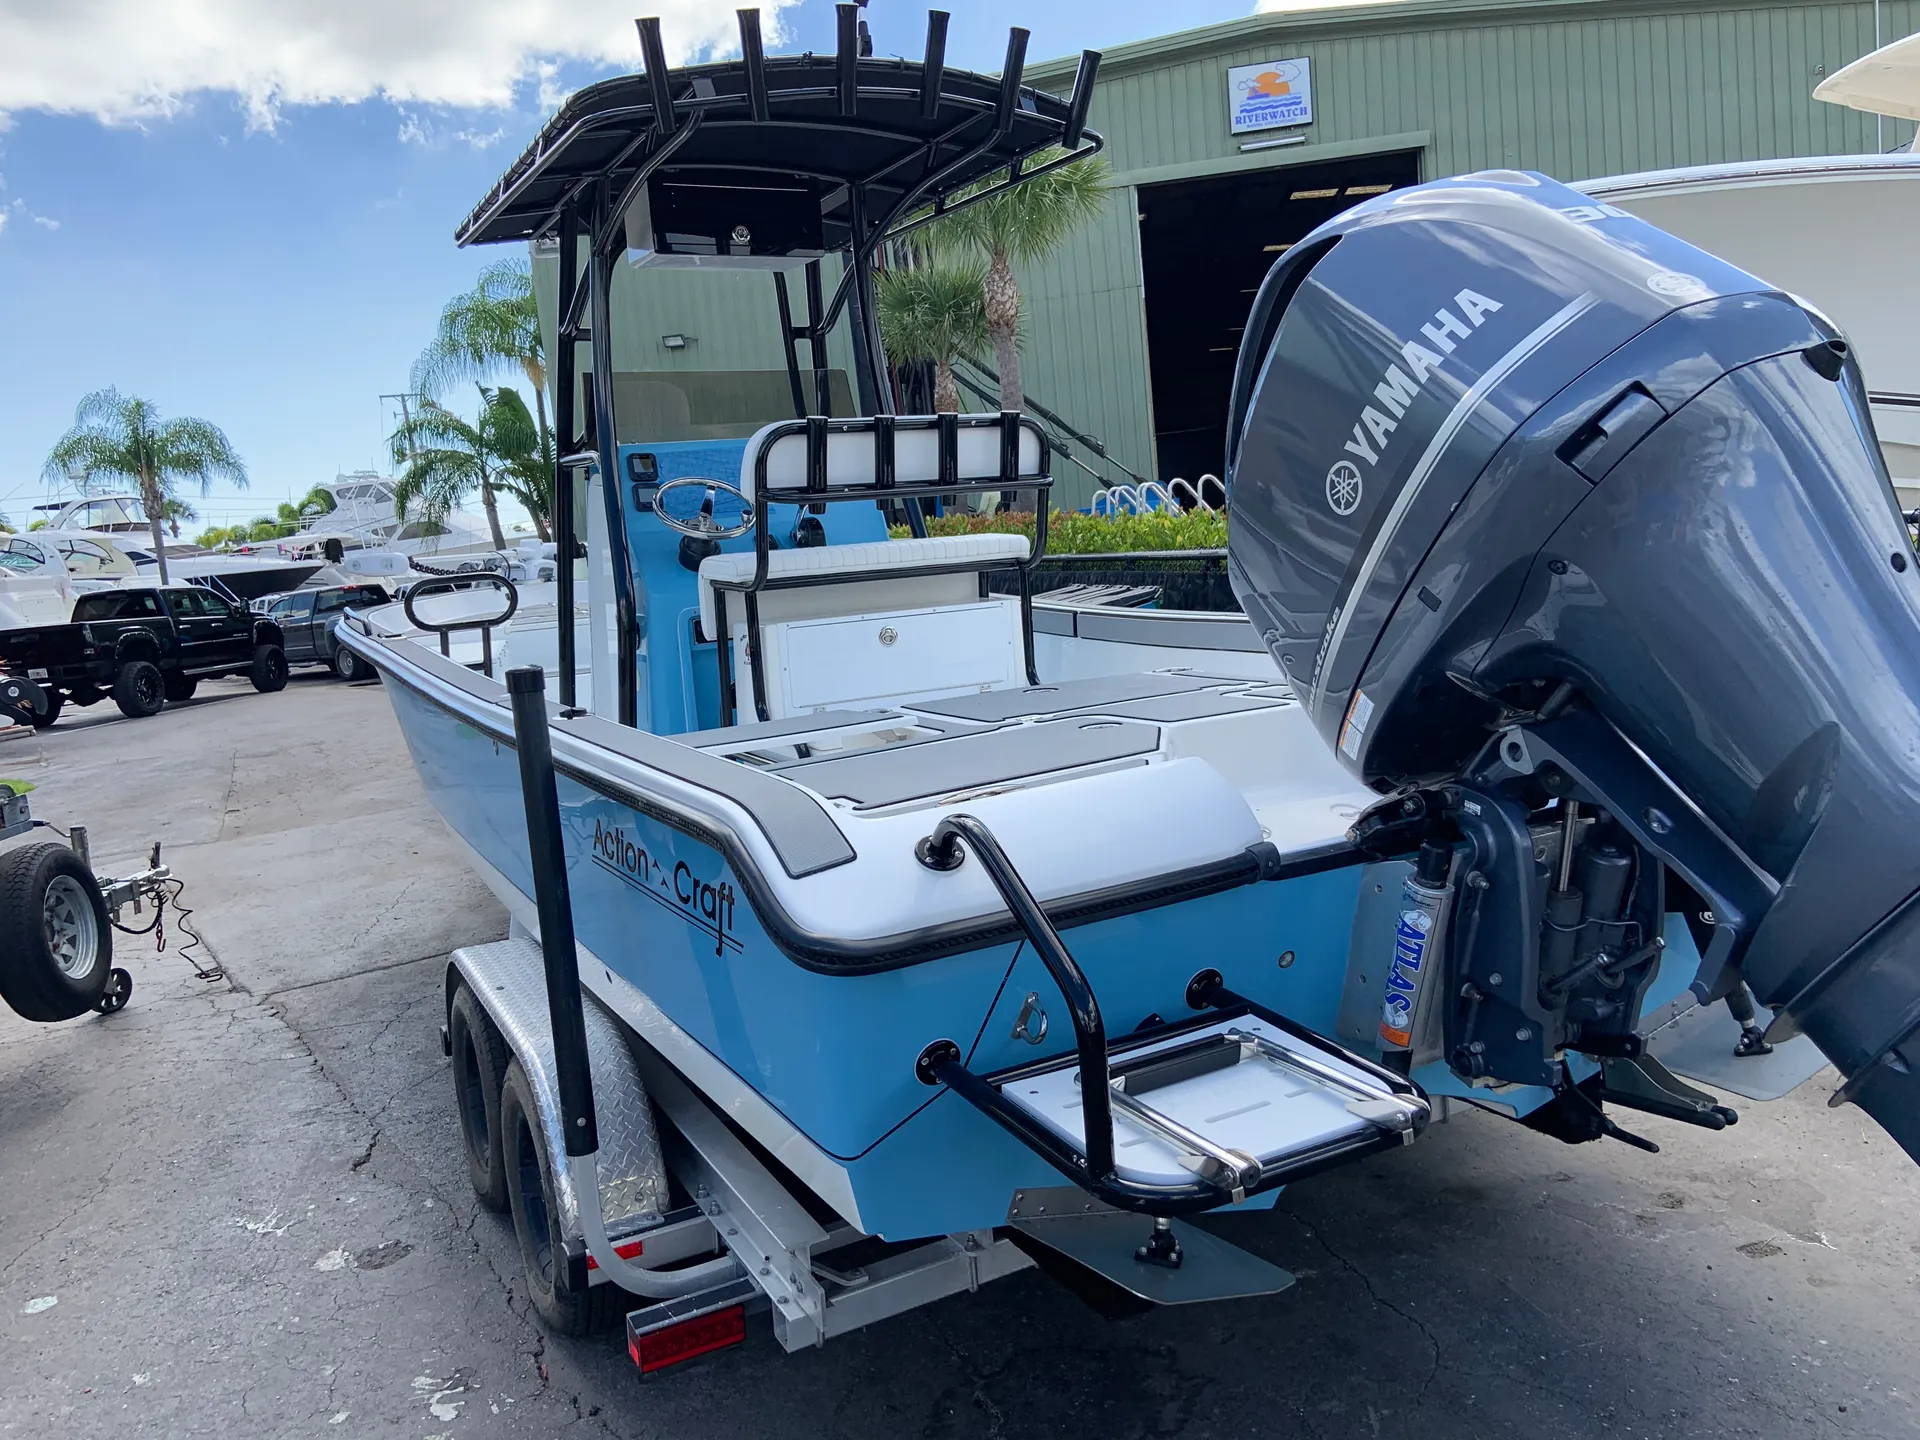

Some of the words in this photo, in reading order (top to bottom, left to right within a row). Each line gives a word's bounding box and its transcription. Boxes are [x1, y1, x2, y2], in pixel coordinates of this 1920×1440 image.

[1235, 107, 1307, 125] RIVERWATCH
[1344, 288, 1504, 466] YAMAHA
[593, 818, 649, 881] Action
[674, 860, 735, 957] Craft
[1385, 911, 1428, 1013] ATLAS
